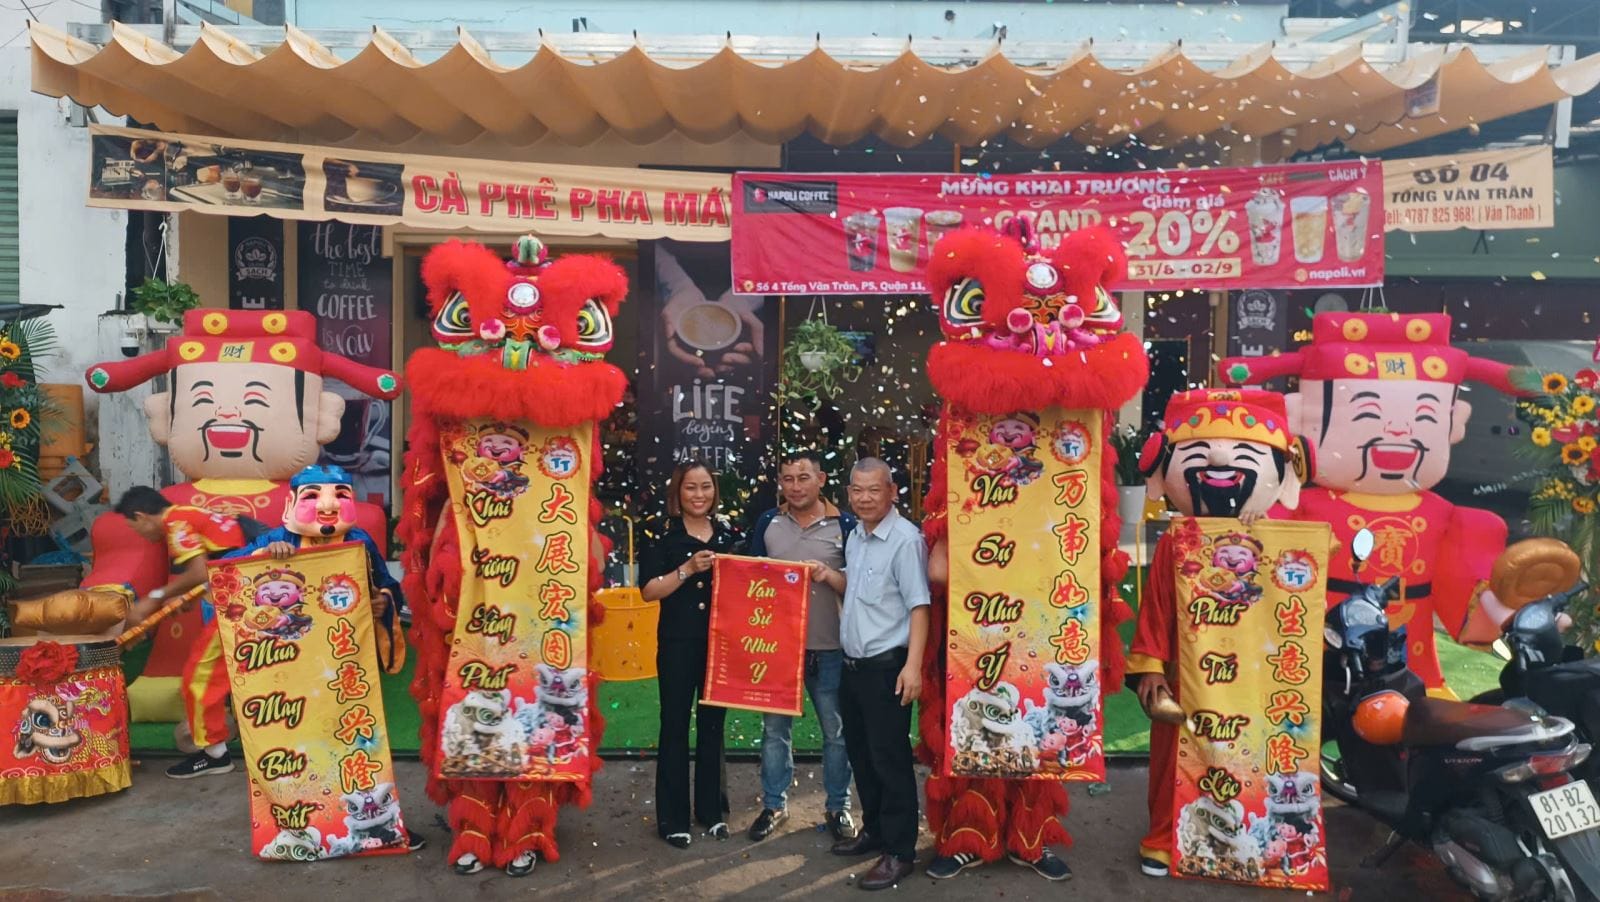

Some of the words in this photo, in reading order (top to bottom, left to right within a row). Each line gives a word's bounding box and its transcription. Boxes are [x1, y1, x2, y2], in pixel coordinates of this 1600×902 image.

[1470, 163, 1509, 183] 04
[799, 190, 830, 201] COFFEE
[1015, 180, 1071, 194] KHAI
[411, 172, 469, 215] CÀ
[478, 177, 559, 220] PHÊ
[569, 187, 653, 225] PHA
[663, 186, 732, 227] MÁ
[1125, 210, 1240, 256] 20%
[327, 261, 366, 278] TIME
[1191, 261, 1233, 275] 02/9
[1309, 267, 1366, 281] napoli.vn
[771, 282, 779, 291] 4
[317, 293, 378, 320] COFFEE
[682, 421, 734, 442] begins
[747, 579, 776, 601] Vạn
[748, 606, 773, 629] Sự
[235, 638, 299, 670] Mua
[741, 636, 778, 654] Như
[750, 660, 768, 684] Ý
[244, 693, 305, 728] May
[1544, 805, 1600, 836] 201.32
